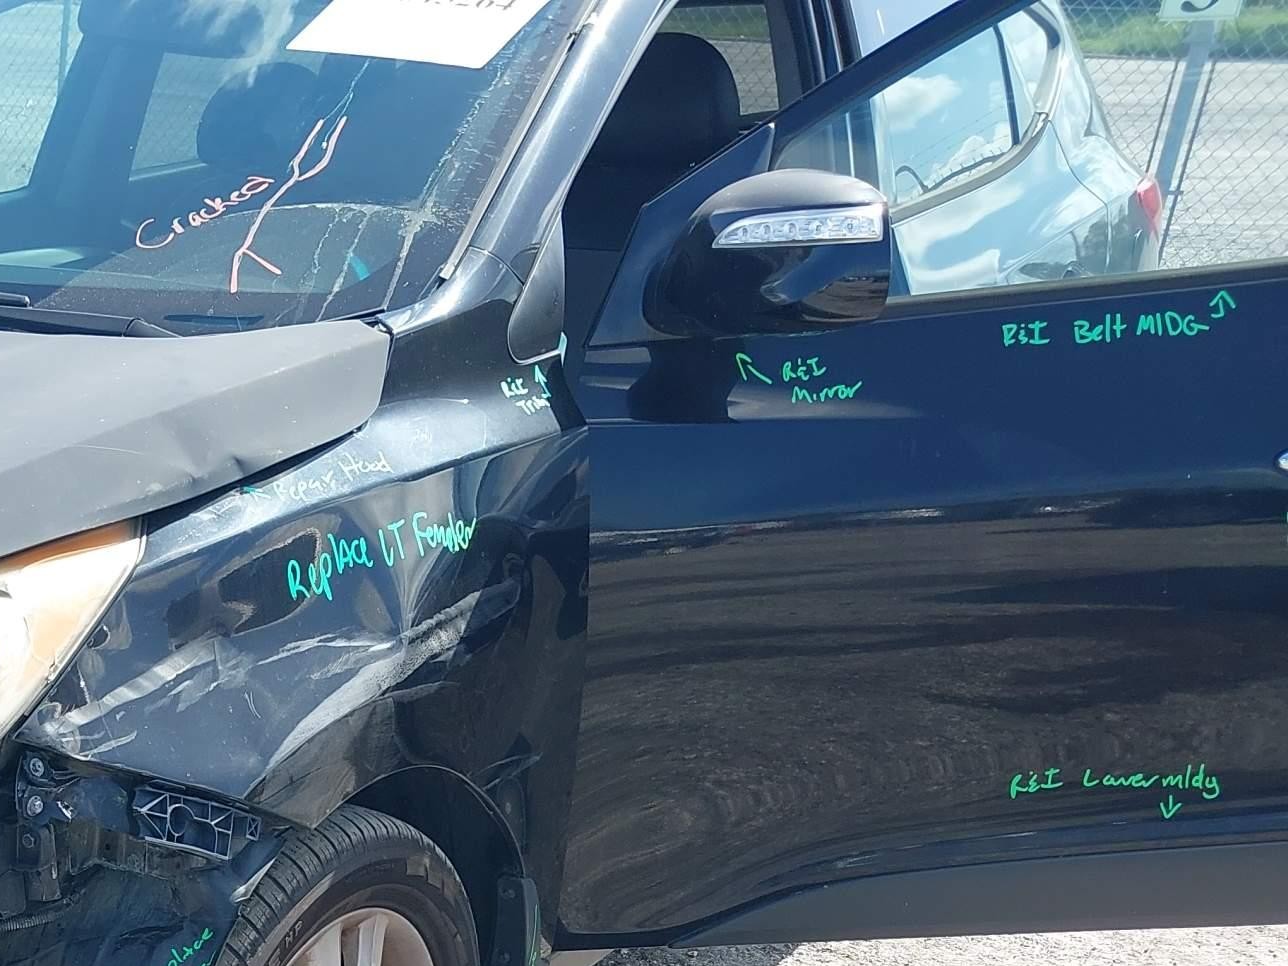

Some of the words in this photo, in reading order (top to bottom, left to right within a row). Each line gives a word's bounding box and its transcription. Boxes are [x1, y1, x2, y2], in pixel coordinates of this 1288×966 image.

[135, 176, 275, 249] Cracked
[1073, 313, 1127, 344] Belt
[791, 381, 862, 404] Mirror
[338, 450, 394, 481] Hood
[412, 511, 477, 557] Fender
